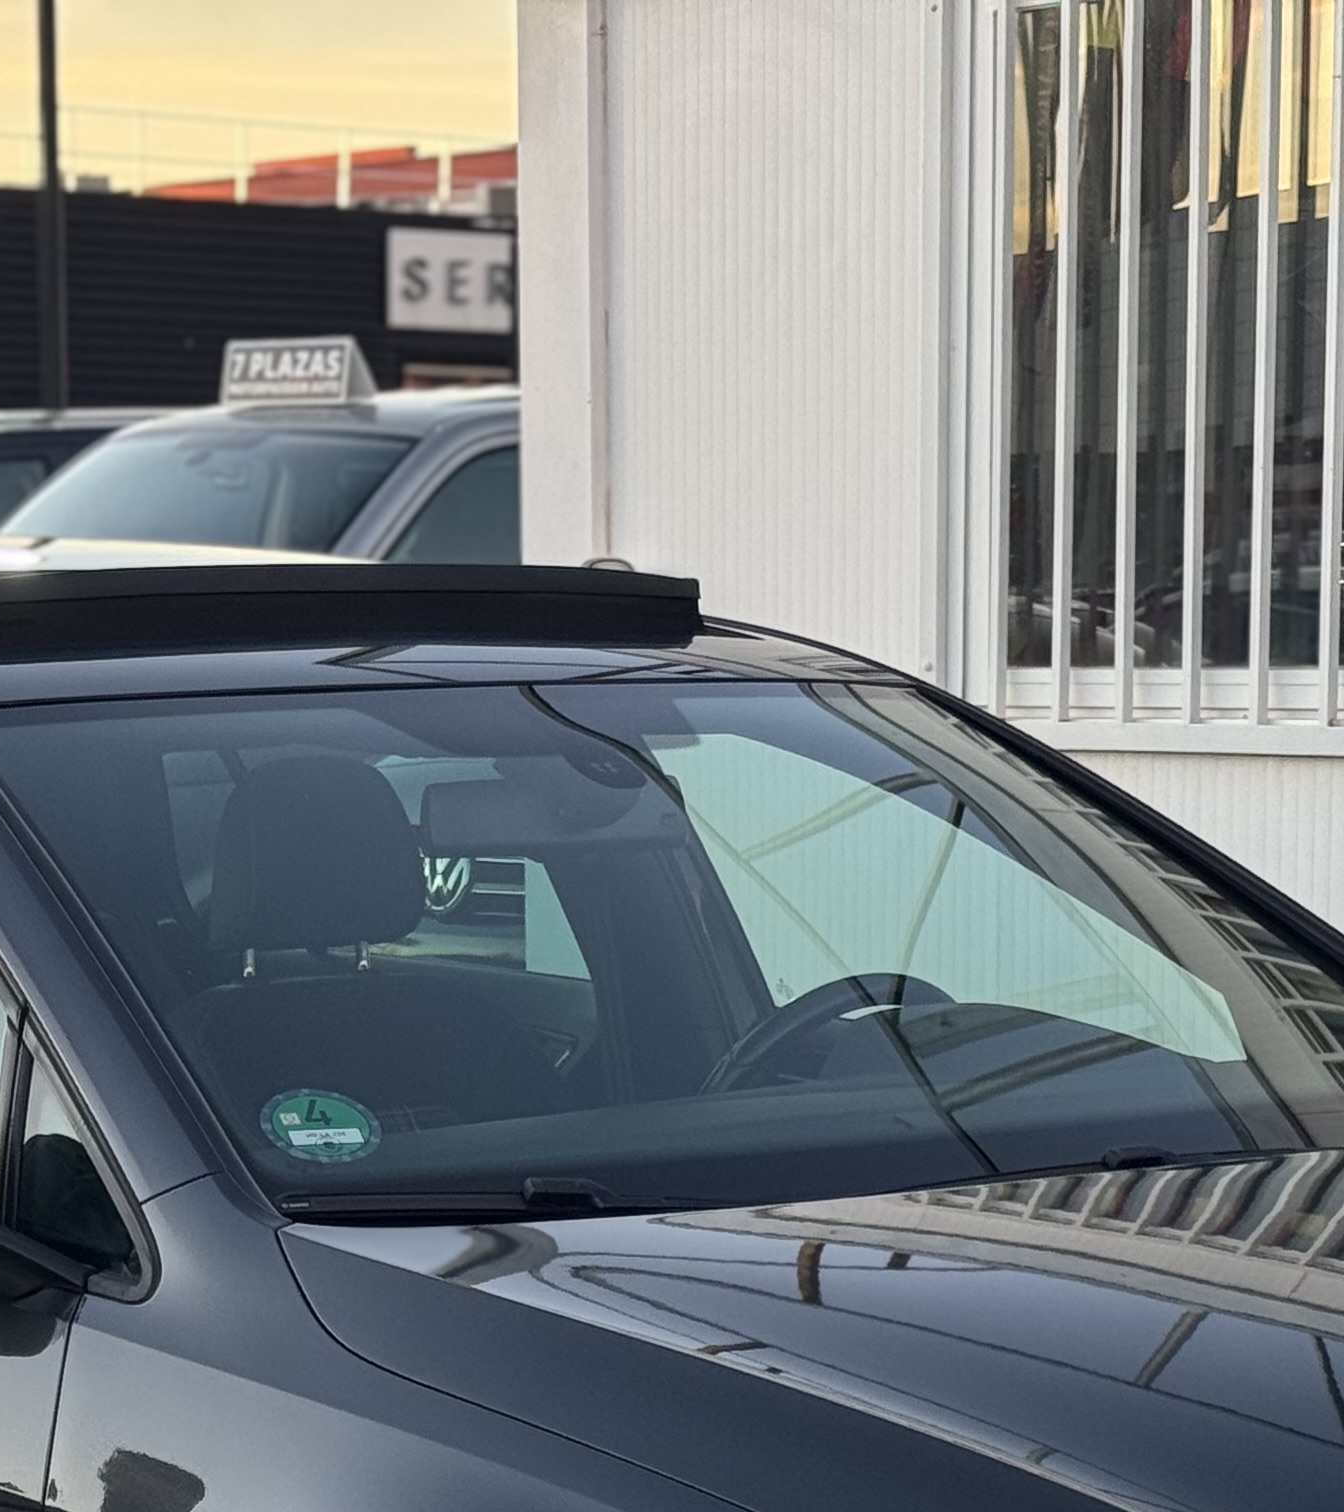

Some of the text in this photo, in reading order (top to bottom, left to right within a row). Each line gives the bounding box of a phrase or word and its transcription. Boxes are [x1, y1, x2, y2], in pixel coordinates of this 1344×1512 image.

[232, 347, 342, 379] 7 PLAZAS
[304, 1098, 333, 1127] 4
